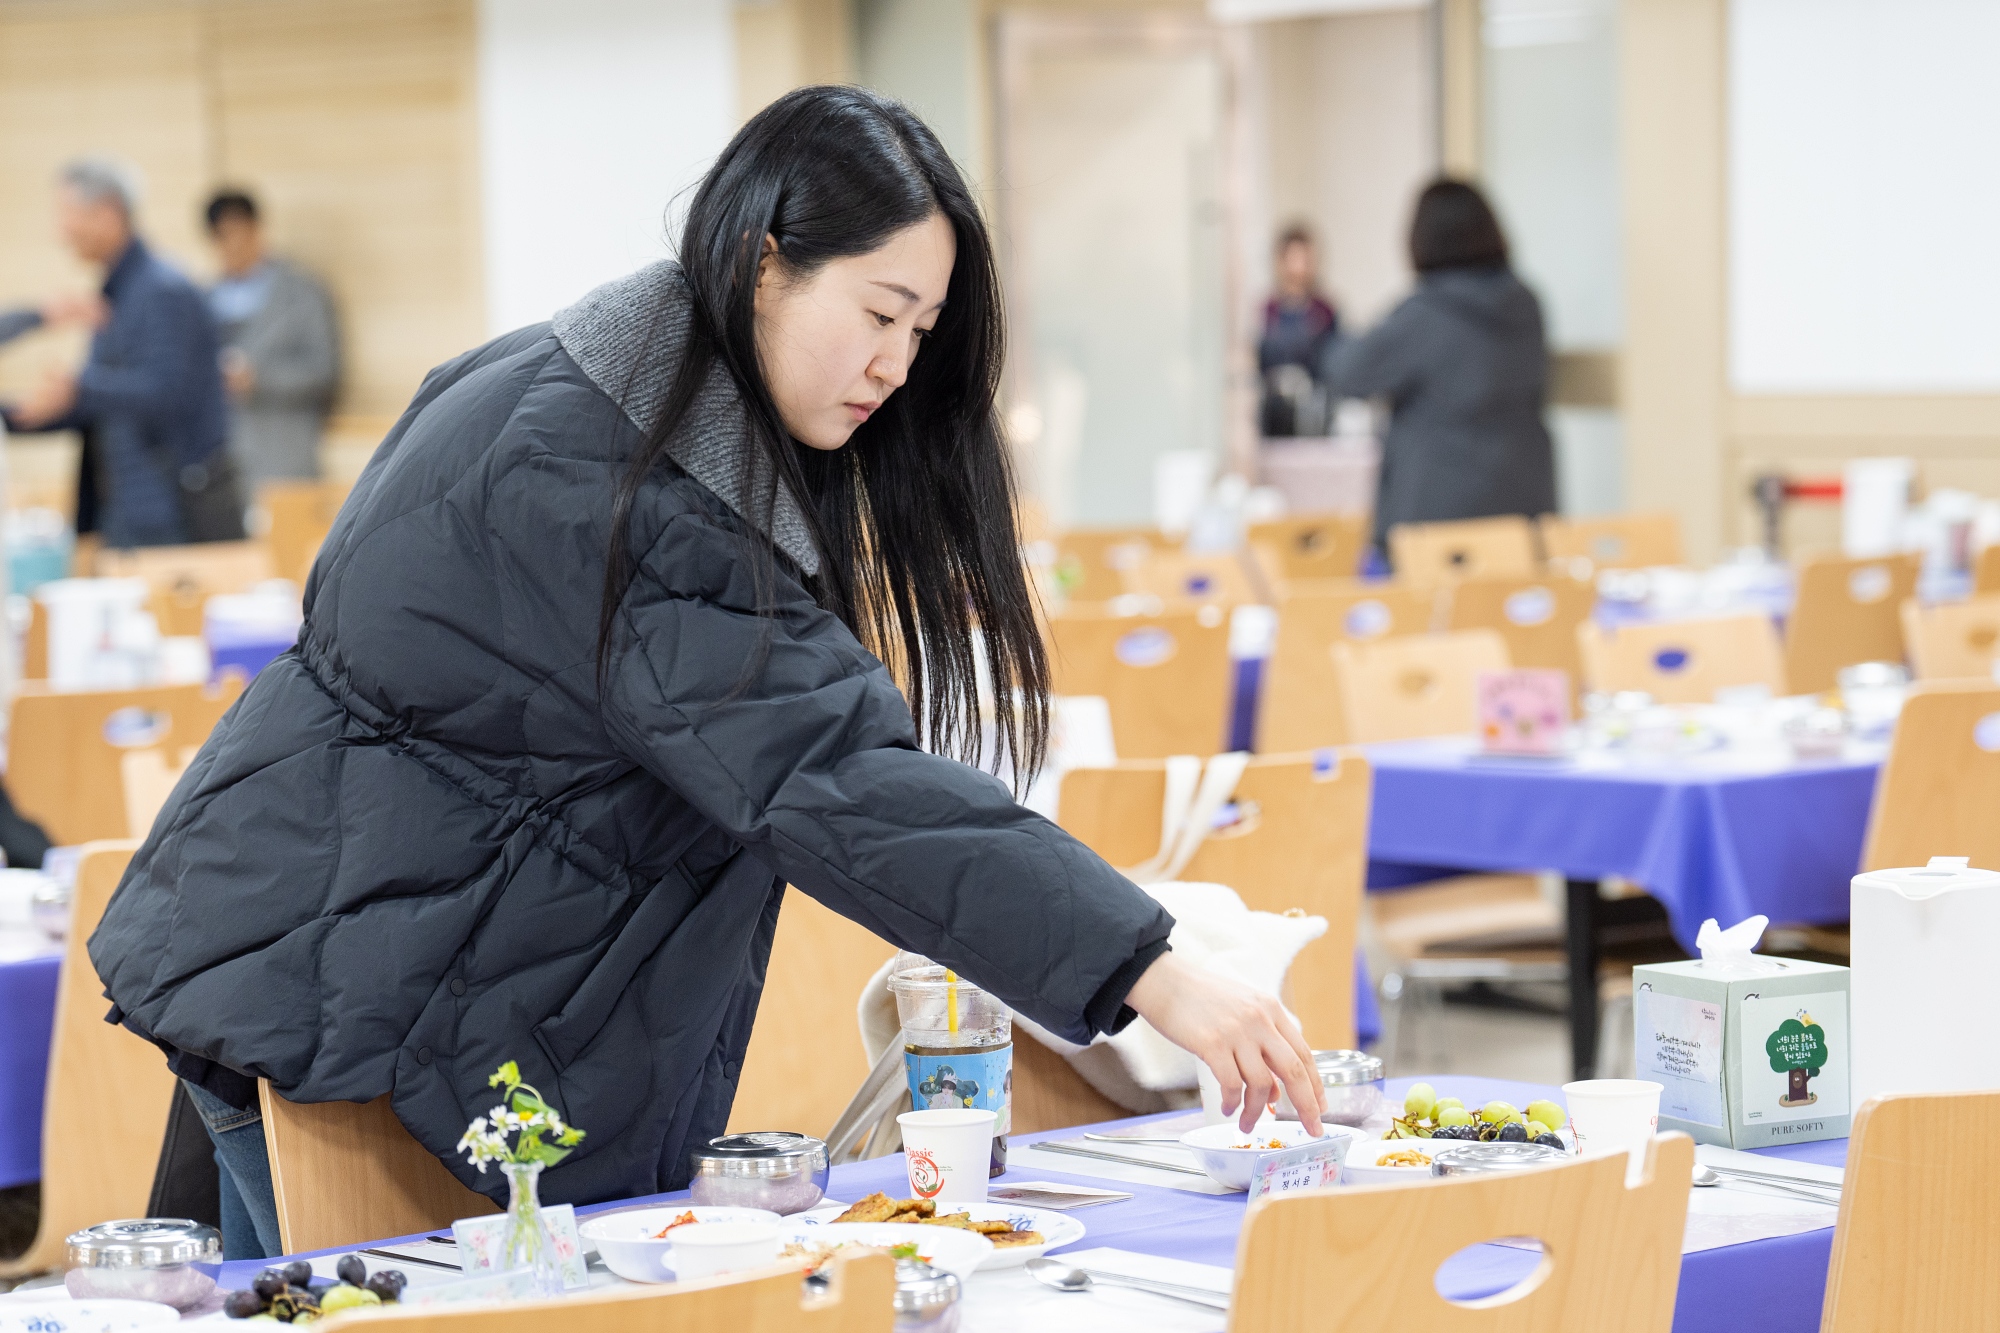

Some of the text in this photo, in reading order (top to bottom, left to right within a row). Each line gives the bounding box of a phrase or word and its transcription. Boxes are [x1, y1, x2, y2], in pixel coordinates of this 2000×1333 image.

[1771, 1121, 1825, 1136] PURE SOFTY
[905, 1146, 933, 1158] Classic
